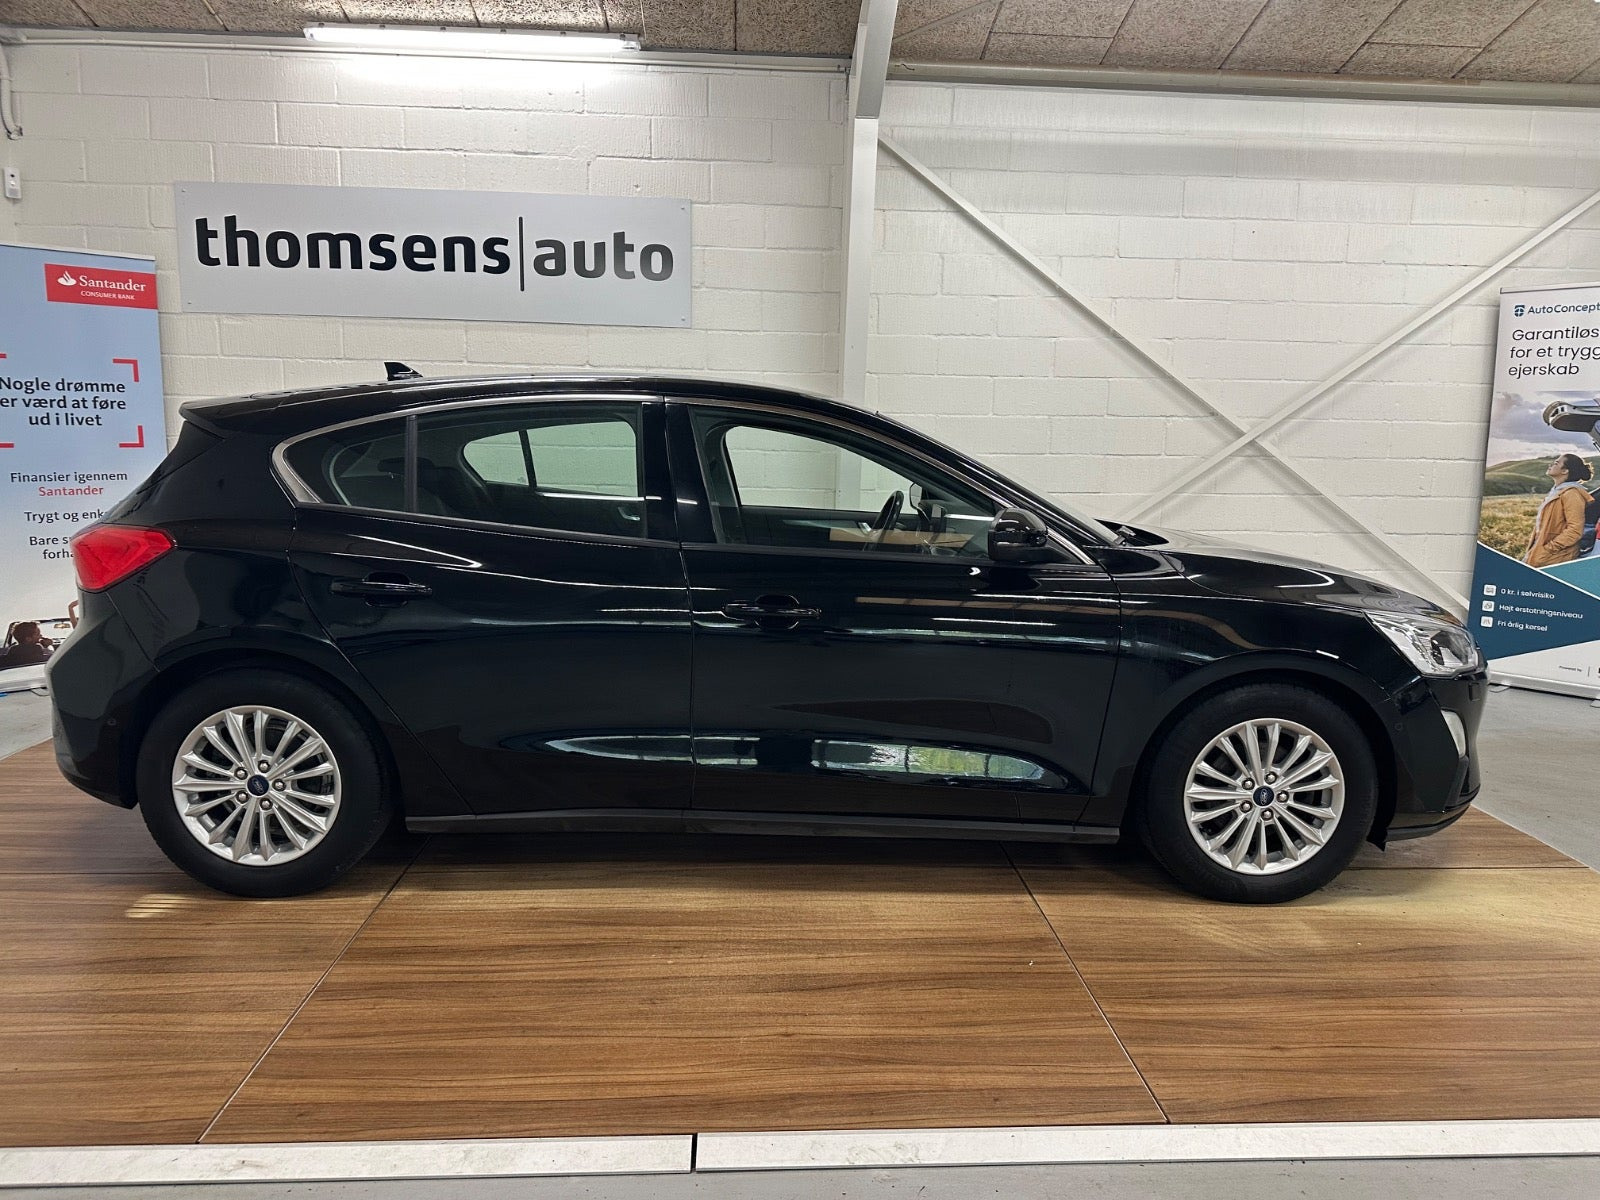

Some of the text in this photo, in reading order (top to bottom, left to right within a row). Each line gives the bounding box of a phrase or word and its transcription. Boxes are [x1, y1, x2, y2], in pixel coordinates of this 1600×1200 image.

[195, 214, 674, 282] thomsens auto
[79, 275, 146, 292] Santander
[80, 290, 117, 299] CONSUMER
[1528, 303, 1600, 314] AutoConcept
[1510, 346, 1532, 358] for
[1536, 346, 1553, 357] et
[1508, 363, 1580, 379] ejerskab
[0, 377, 126, 394] Nogle drømme
[0, 396, 126, 410] er værd at føre
[28, 412, 103, 426] ud i livet
[10, 471, 128, 484] Finansier igennem
[38, 485, 104, 497] Santander
[24, 509, 108, 523] Trygt og enk
[29, 536, 59, 546] Bare
